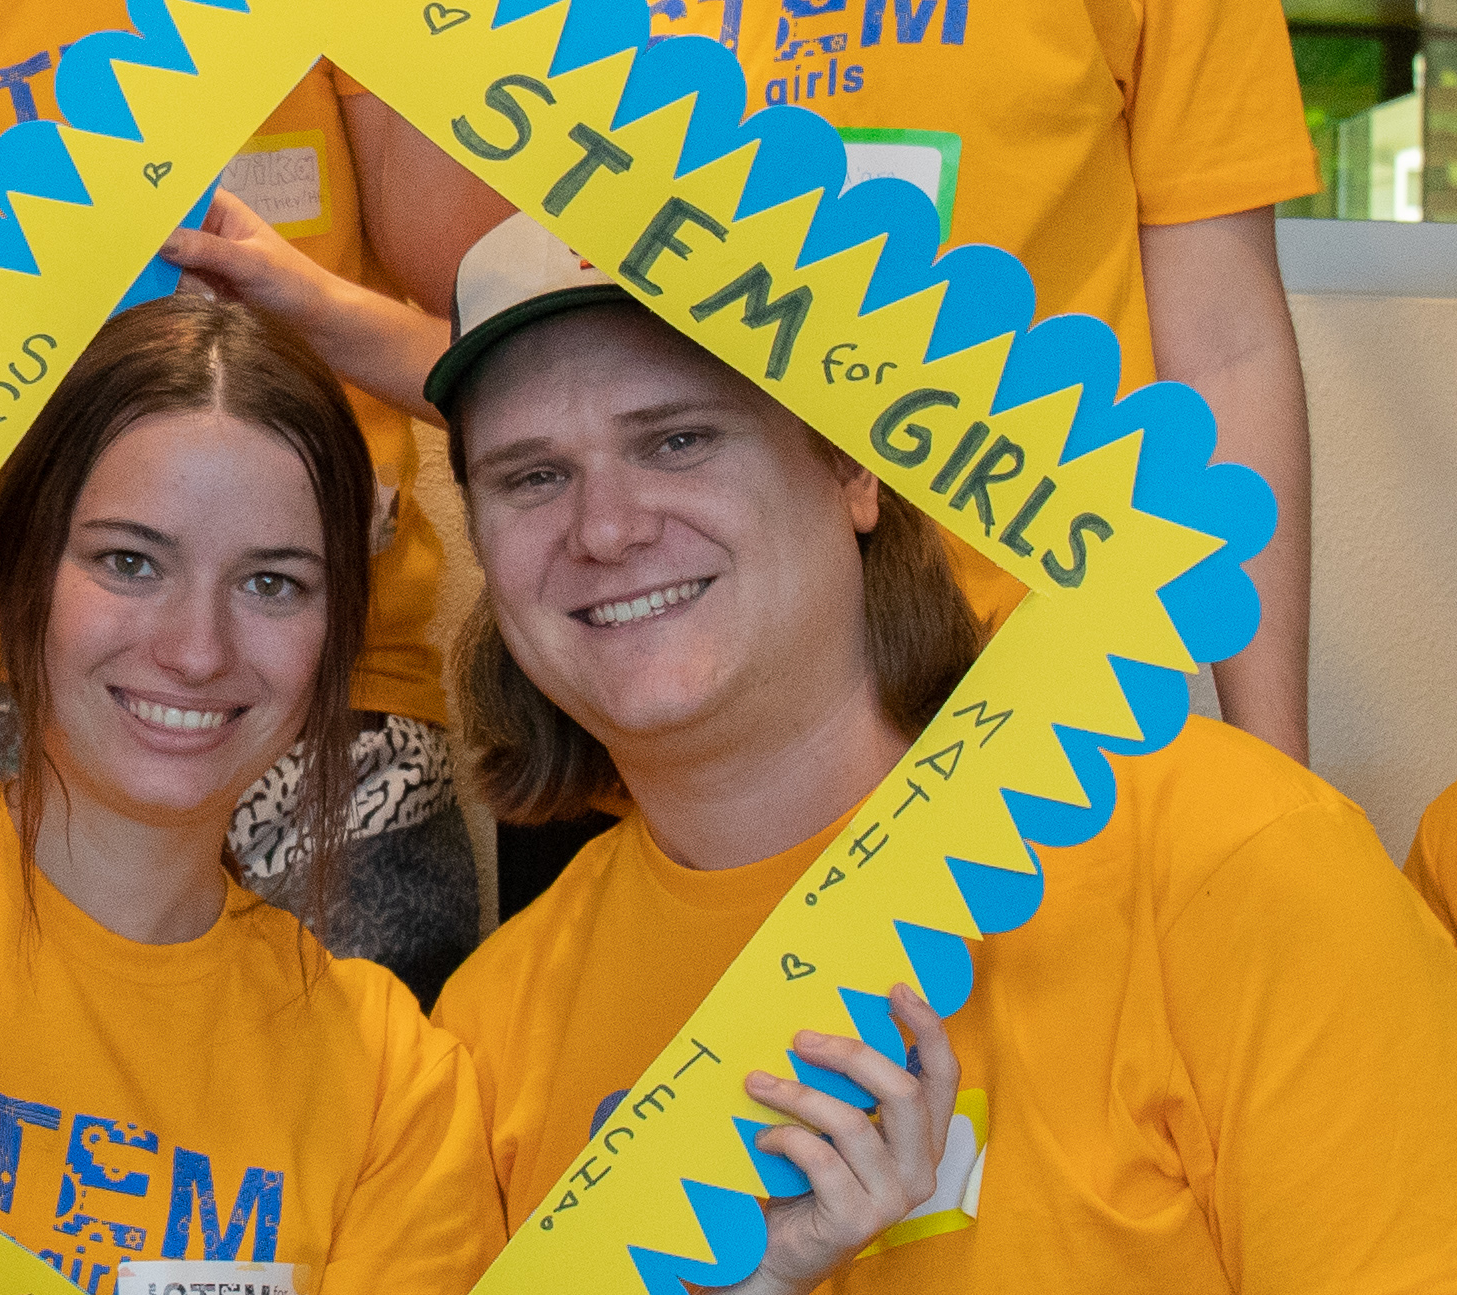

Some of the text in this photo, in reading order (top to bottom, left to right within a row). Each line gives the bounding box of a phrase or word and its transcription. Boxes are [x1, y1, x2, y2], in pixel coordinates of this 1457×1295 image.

[451, 74, 1114, 589] STEM for GIRLS
